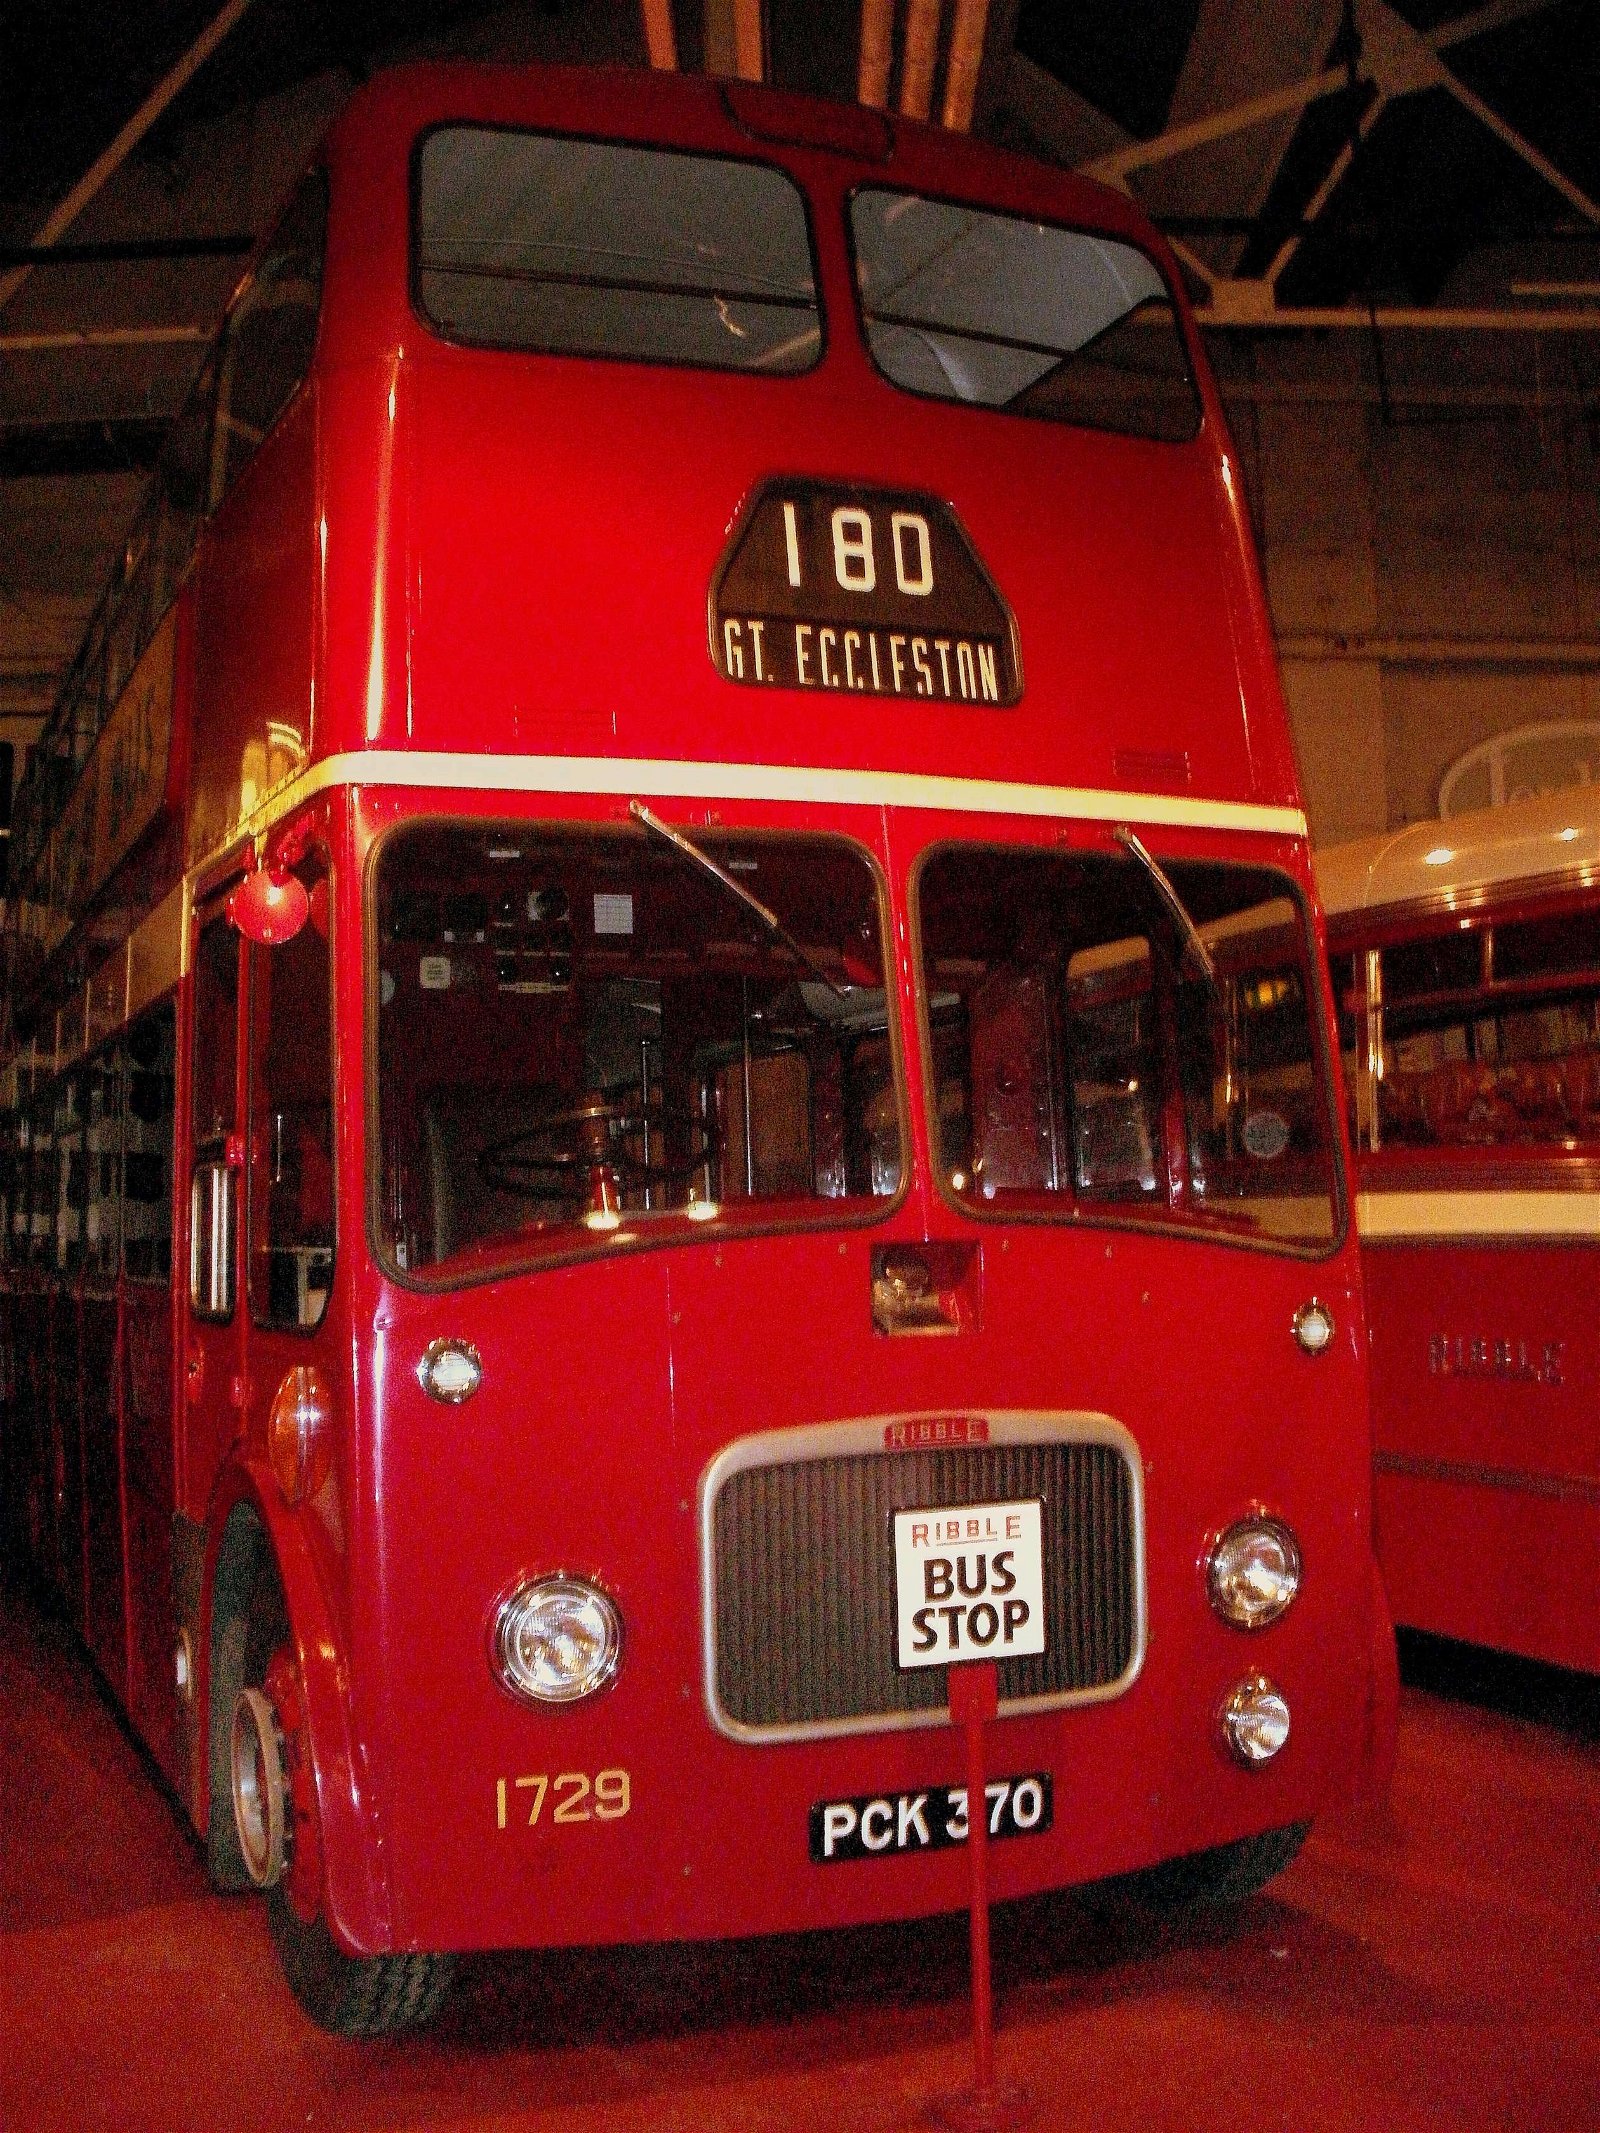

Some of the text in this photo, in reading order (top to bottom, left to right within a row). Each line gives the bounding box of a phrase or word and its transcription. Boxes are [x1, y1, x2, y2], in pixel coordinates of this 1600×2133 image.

[783, 501, 934, 597] 180
[724, 619, 774, 682] GT.
[1428, 1333, 1566, 1386] RIBBLE
[891, 1418, 985, 1448] RIBBLE
[911, 1515, 1023, 1549] RIBBLE
[923, 1550, 1018, 1604] BUS
[911, 1599, 1031, 1654] STOP
[496, 1768, 631, 1829] 1729
[823, 1778, 1043, 1857] PCK 370
